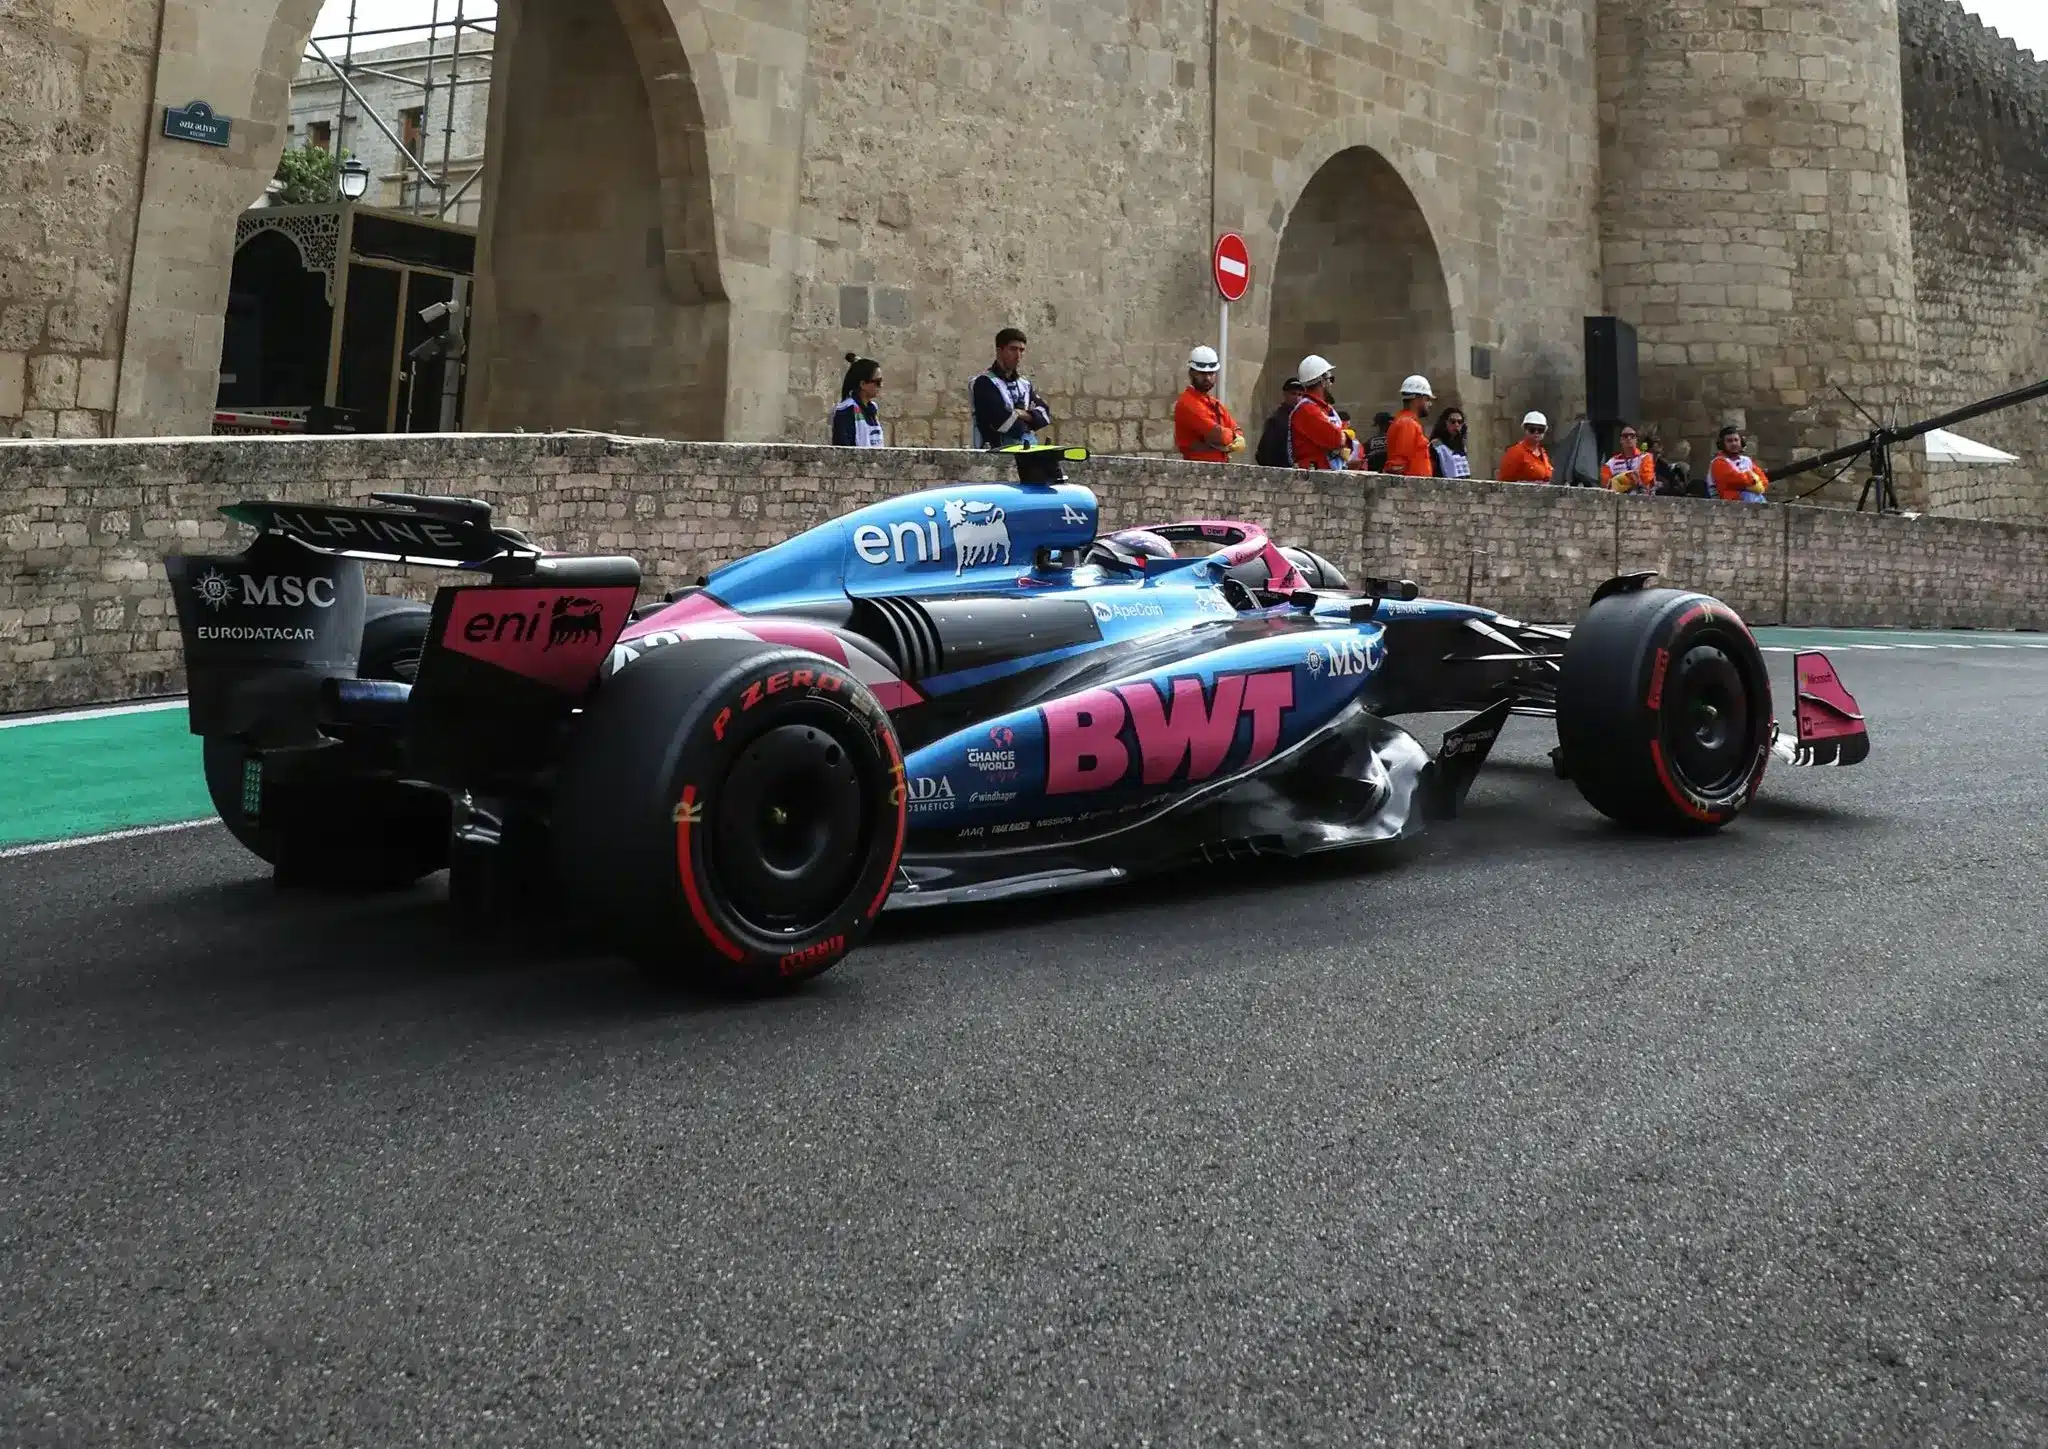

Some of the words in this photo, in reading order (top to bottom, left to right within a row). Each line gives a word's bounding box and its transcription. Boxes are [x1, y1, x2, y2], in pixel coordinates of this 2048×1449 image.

[273, 511, 462, 547] ALPINE
[853, 506, 941, 564] eni
[239, 574, 336, 607] MSC
[463, 601, 546, 643] eni
[1111, 602, 1164, 620] ApeCoin
[1396, 604, 1427, 615] BINANCE
[197, 627, 315, 640] EURODATACAR
[1323, 638, 1380, 677] MSC
[713, 706, 732, 741] P
[740, 669, 845, 712] ZERO
[1038, 671, 1294, 795] BWT
[968, 751, 1016, 763] CHANGE
[979, 761, 1016, 771] WORLD
[978, 790, 1017, 802] windhager
